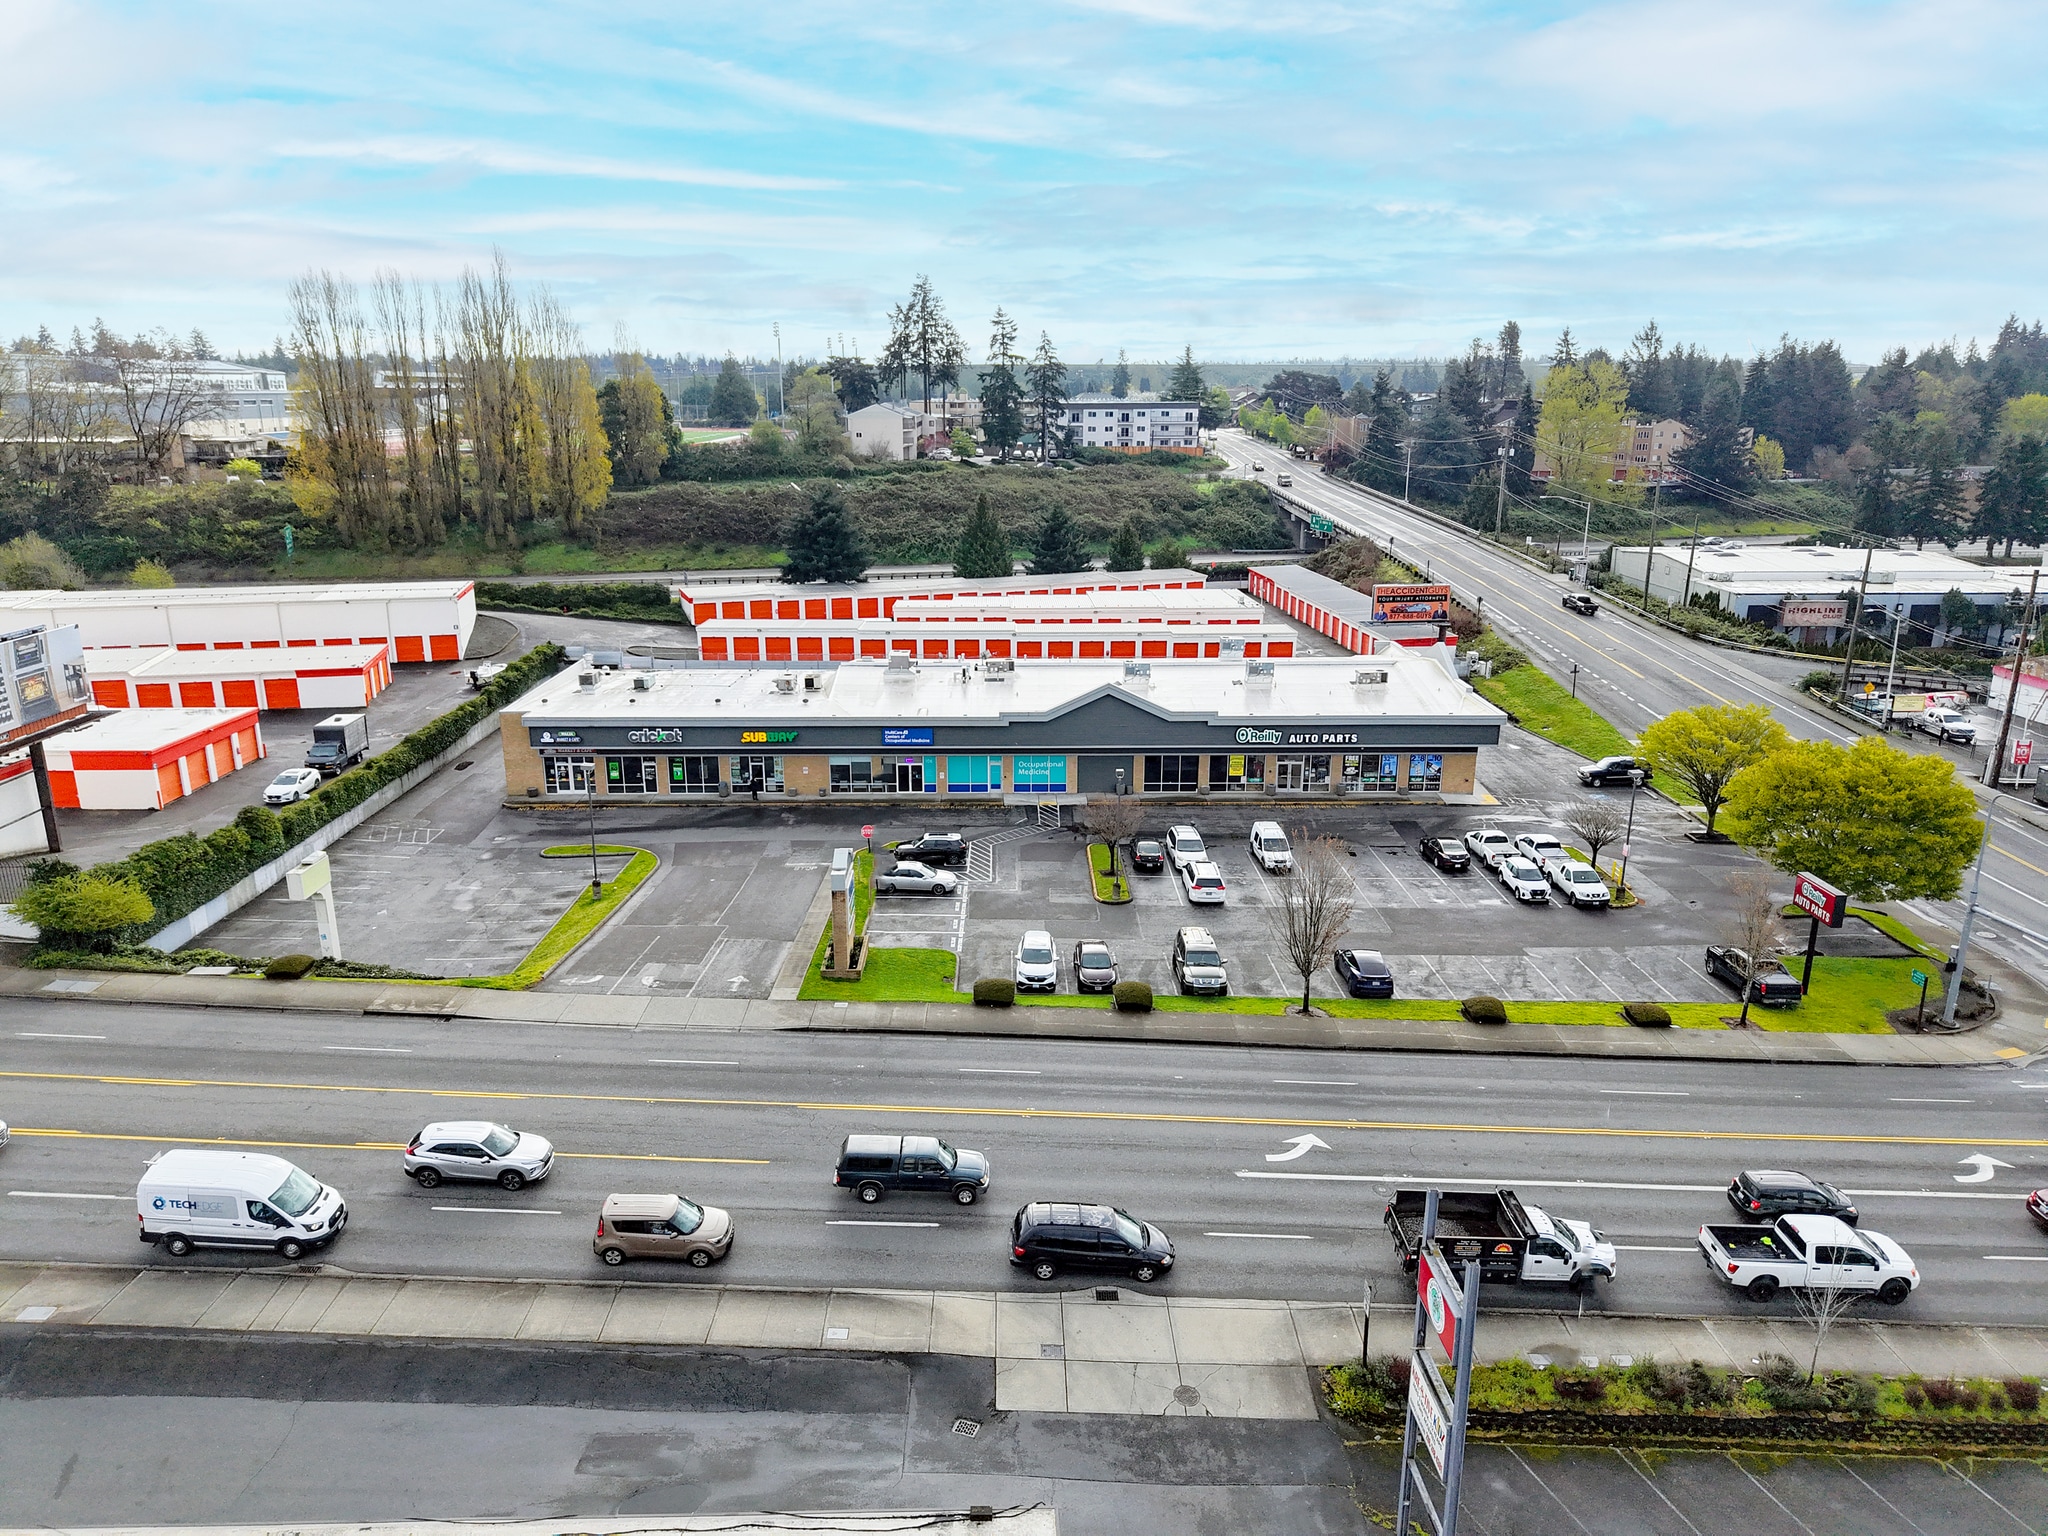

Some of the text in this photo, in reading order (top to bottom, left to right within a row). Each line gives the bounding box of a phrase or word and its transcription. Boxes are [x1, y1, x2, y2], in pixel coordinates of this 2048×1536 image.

[628, 729, 682, 743] cricket
[741, 731, 798, 743] SUBWAY
[1236, 727, 1358, 744] O'Reilly AUTO PARTS
[1802, 882, 1826, 908] O'Reilly
[1795, 894, 1830, 922] AUTO PARTS
